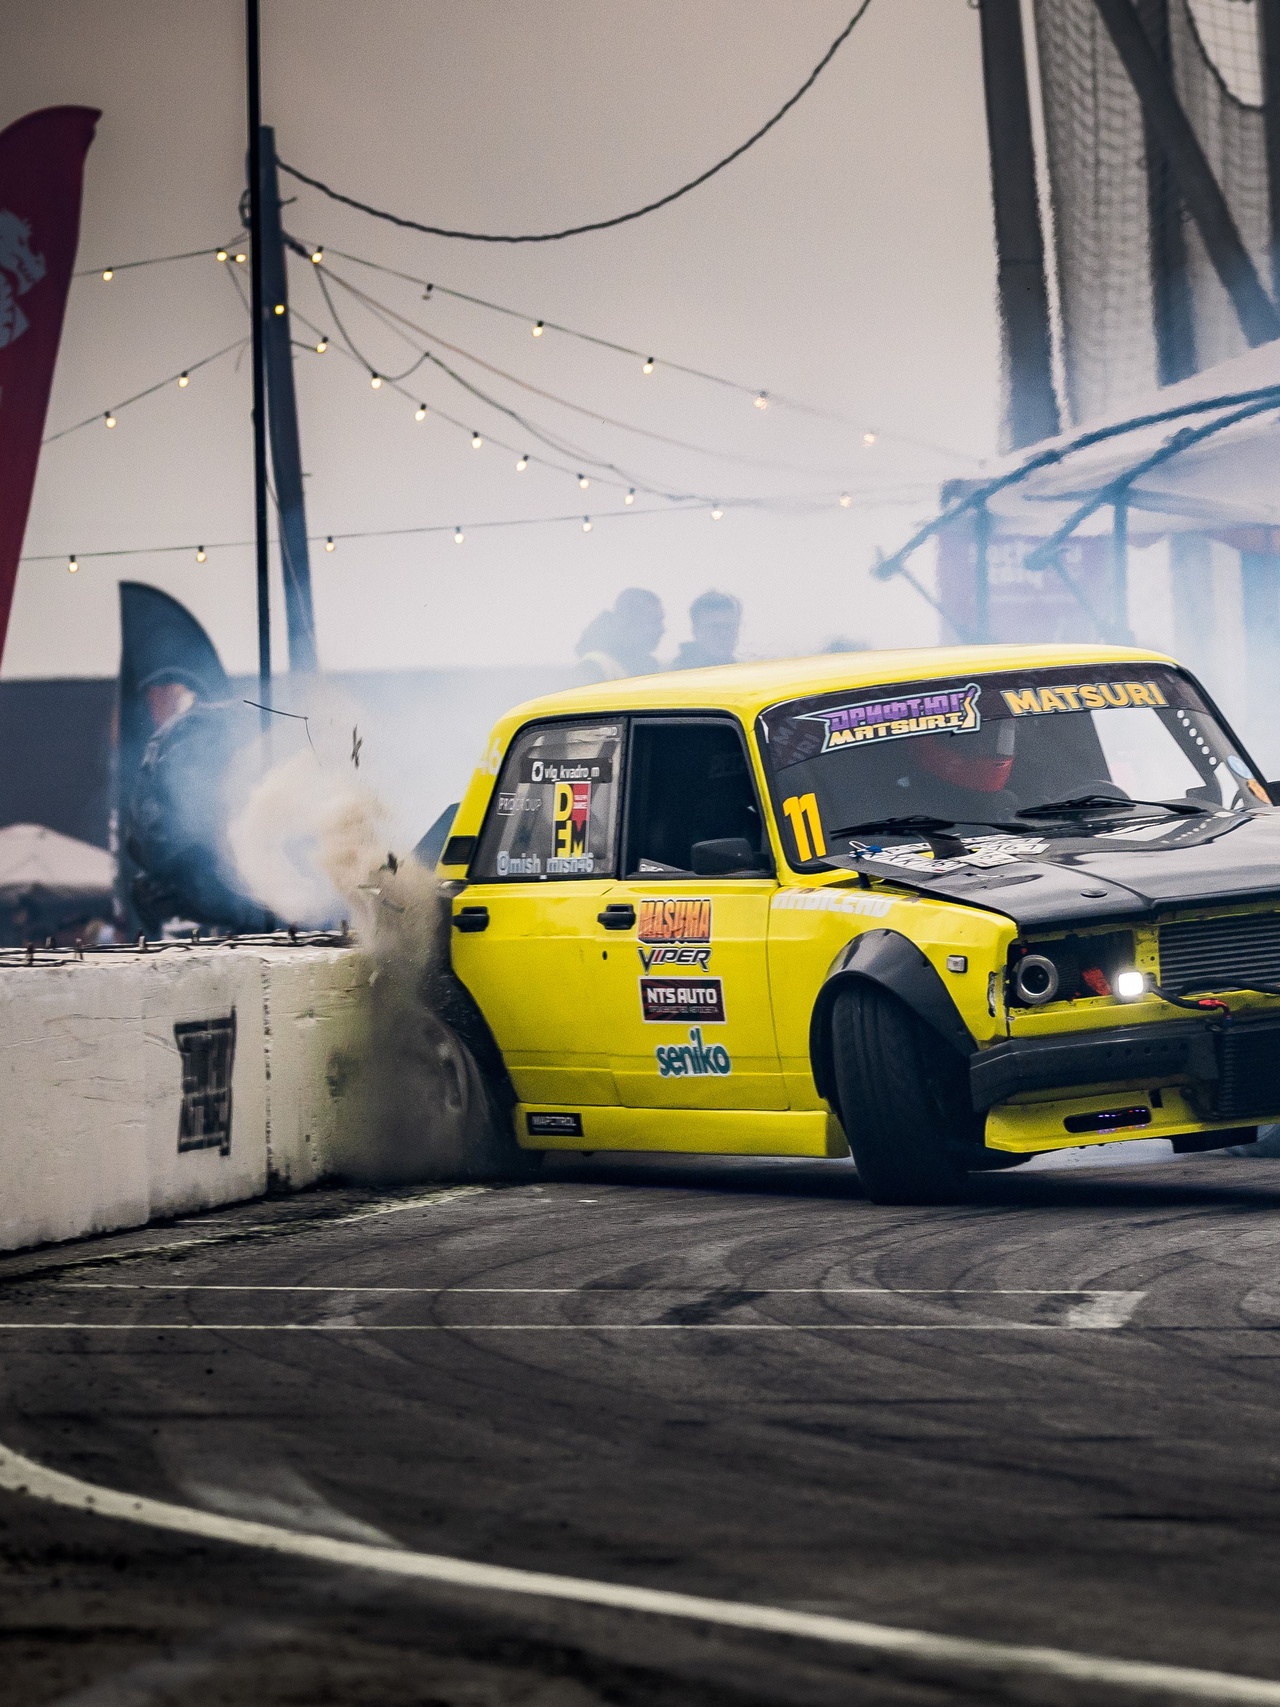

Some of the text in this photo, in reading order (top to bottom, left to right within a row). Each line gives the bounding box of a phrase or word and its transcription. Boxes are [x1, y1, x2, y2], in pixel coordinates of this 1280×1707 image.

[1003, 682, 1167, 716] MATSURI
[828, 712, 963, 747] MATSURI
[782, 792, 827, 863] 11
[638, 899, 711, 943] MASUMA
[637, 946, 711, 975] VIPER
[655, 1027, 731, 1077] seniko
